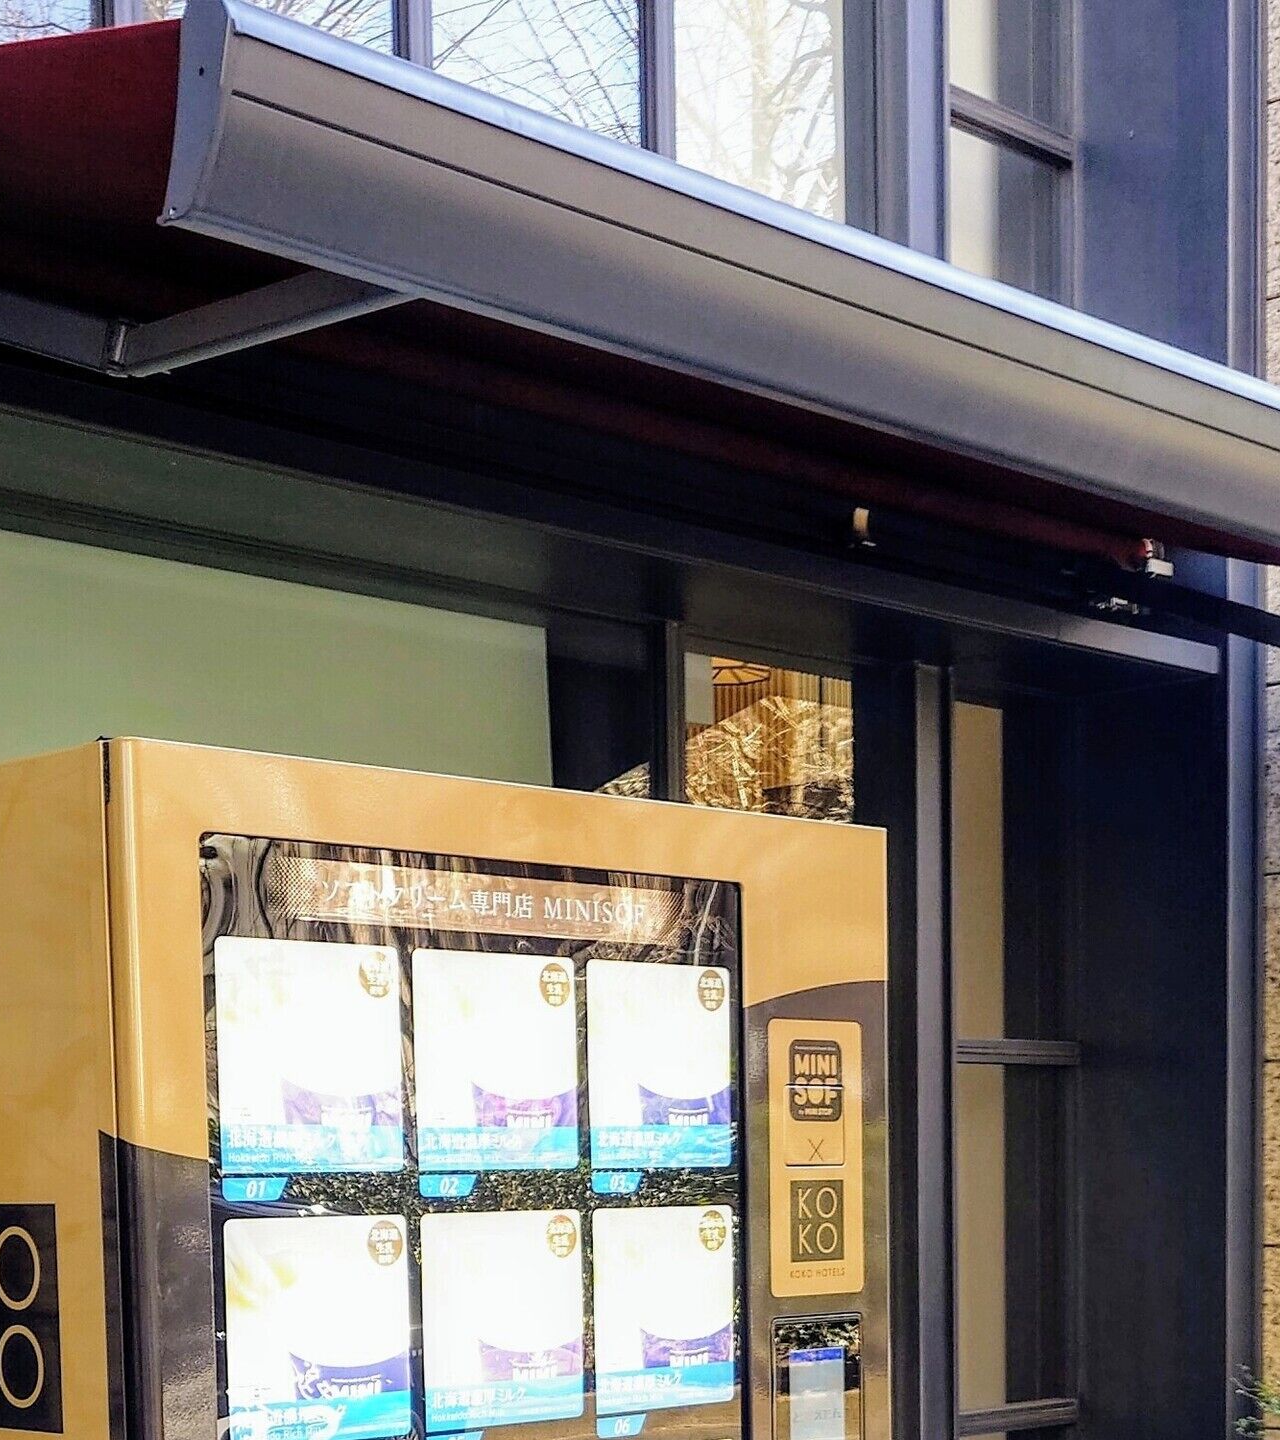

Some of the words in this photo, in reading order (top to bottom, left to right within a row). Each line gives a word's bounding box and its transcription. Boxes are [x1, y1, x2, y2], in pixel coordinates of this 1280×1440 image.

[544, 895, 647, 926] MINISOF
[794, 1053, 837, 1077] MINI
[793, 1076, 839, 1106] SOF
[246, 1180, 267, 1199] 01
[439, 1177, 459, 1195] 02
[609, 1174, 626, 1190] 03
[797, 1186, 837, 1219] KO
[798, 1221, 838, 1255] KO
[614, 1418, 631, 1436] 06
